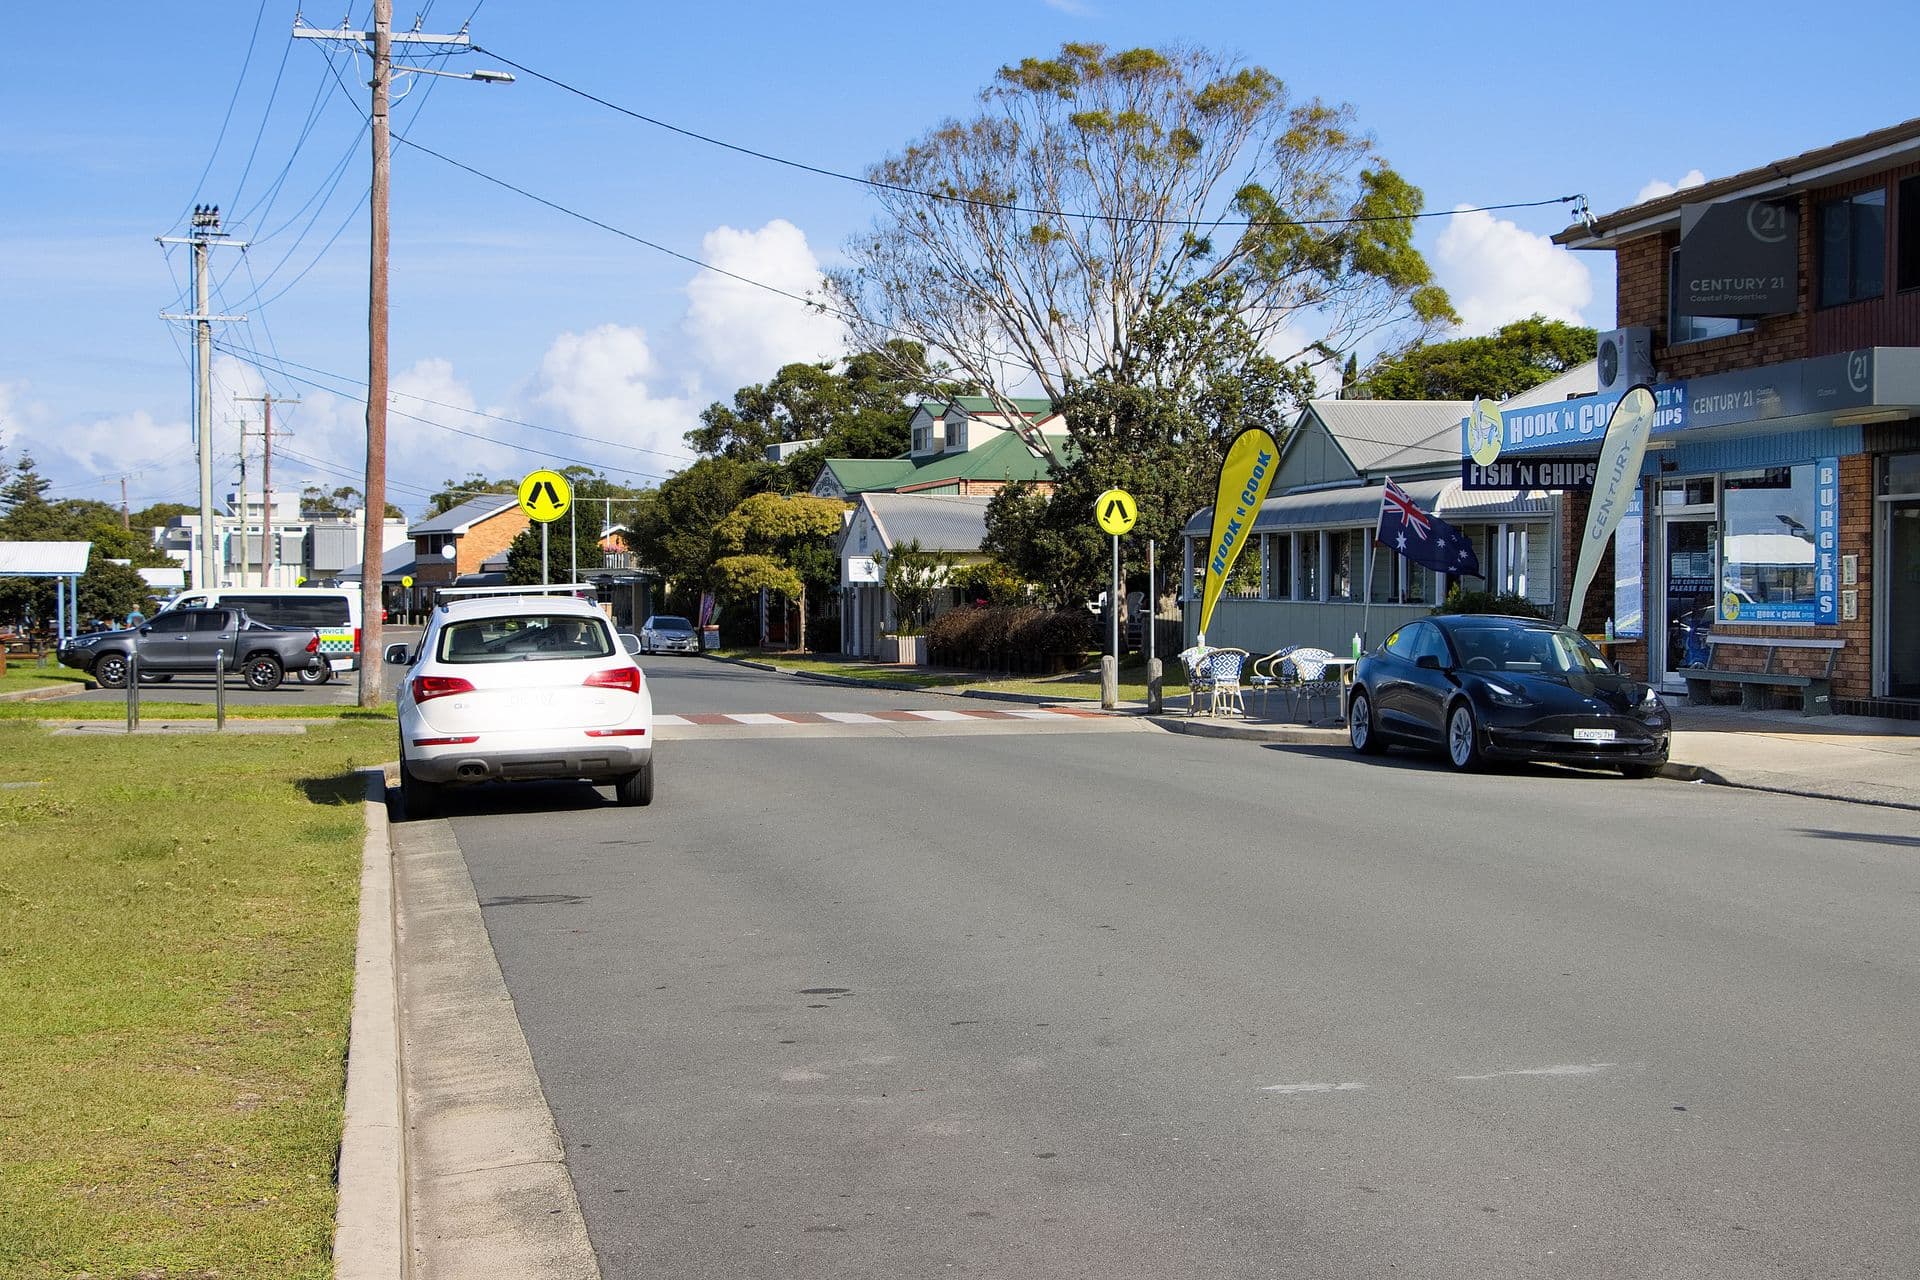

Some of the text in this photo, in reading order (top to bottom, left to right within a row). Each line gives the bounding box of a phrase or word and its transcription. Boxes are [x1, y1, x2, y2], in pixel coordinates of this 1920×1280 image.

[1760, 206, 1785, 230] 21
[1690, 277, 1785, 291] CENTURY 21
[1724, 293, 1767, 303] Properties
[1854, 355, 1867, 379] 21
[1656, 389, 1670, 408] SH
[1693, 390, 1752, 415] CENTURY 21
[1510, 401, 1617, 445] HOOK 'N COO
[1652, 408, 1682, 428] HIPS
[1470, 461, 1596, 486] FISH 'N CHIPS
[1592, 439, 1631, 540] CENTURY
[1211, 449, 1272, 576] HOOK N COOK
[1820, 467, 1833, 613] BURGERS
